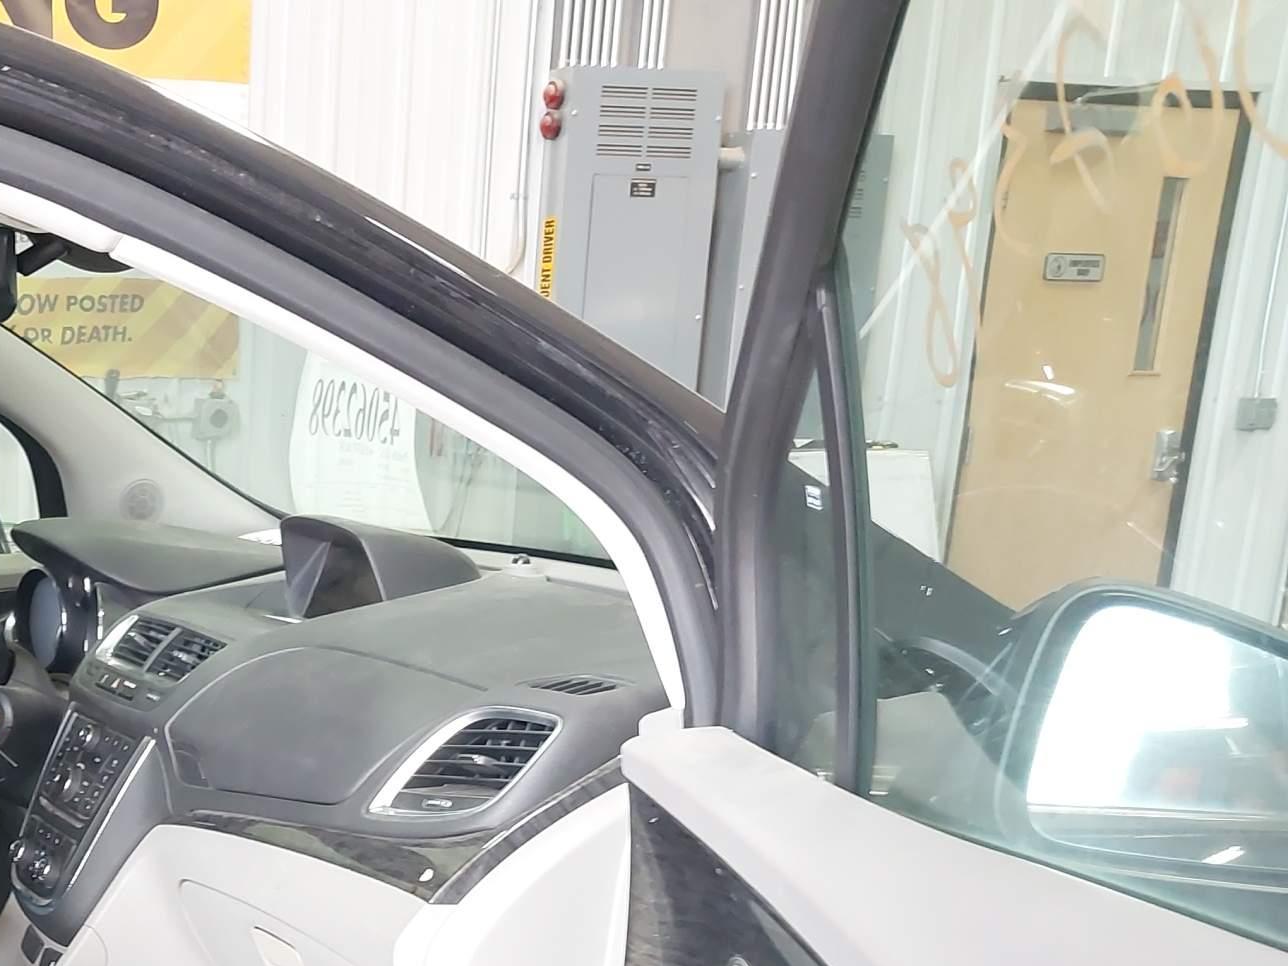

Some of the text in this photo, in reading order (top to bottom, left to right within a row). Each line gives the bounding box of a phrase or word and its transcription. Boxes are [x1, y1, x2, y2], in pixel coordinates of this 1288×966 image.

[542, 219, 555, 264] DRIVER
[66, 293, 145, 313] POSTED
[61, 325, 133, 345] DEATH.
